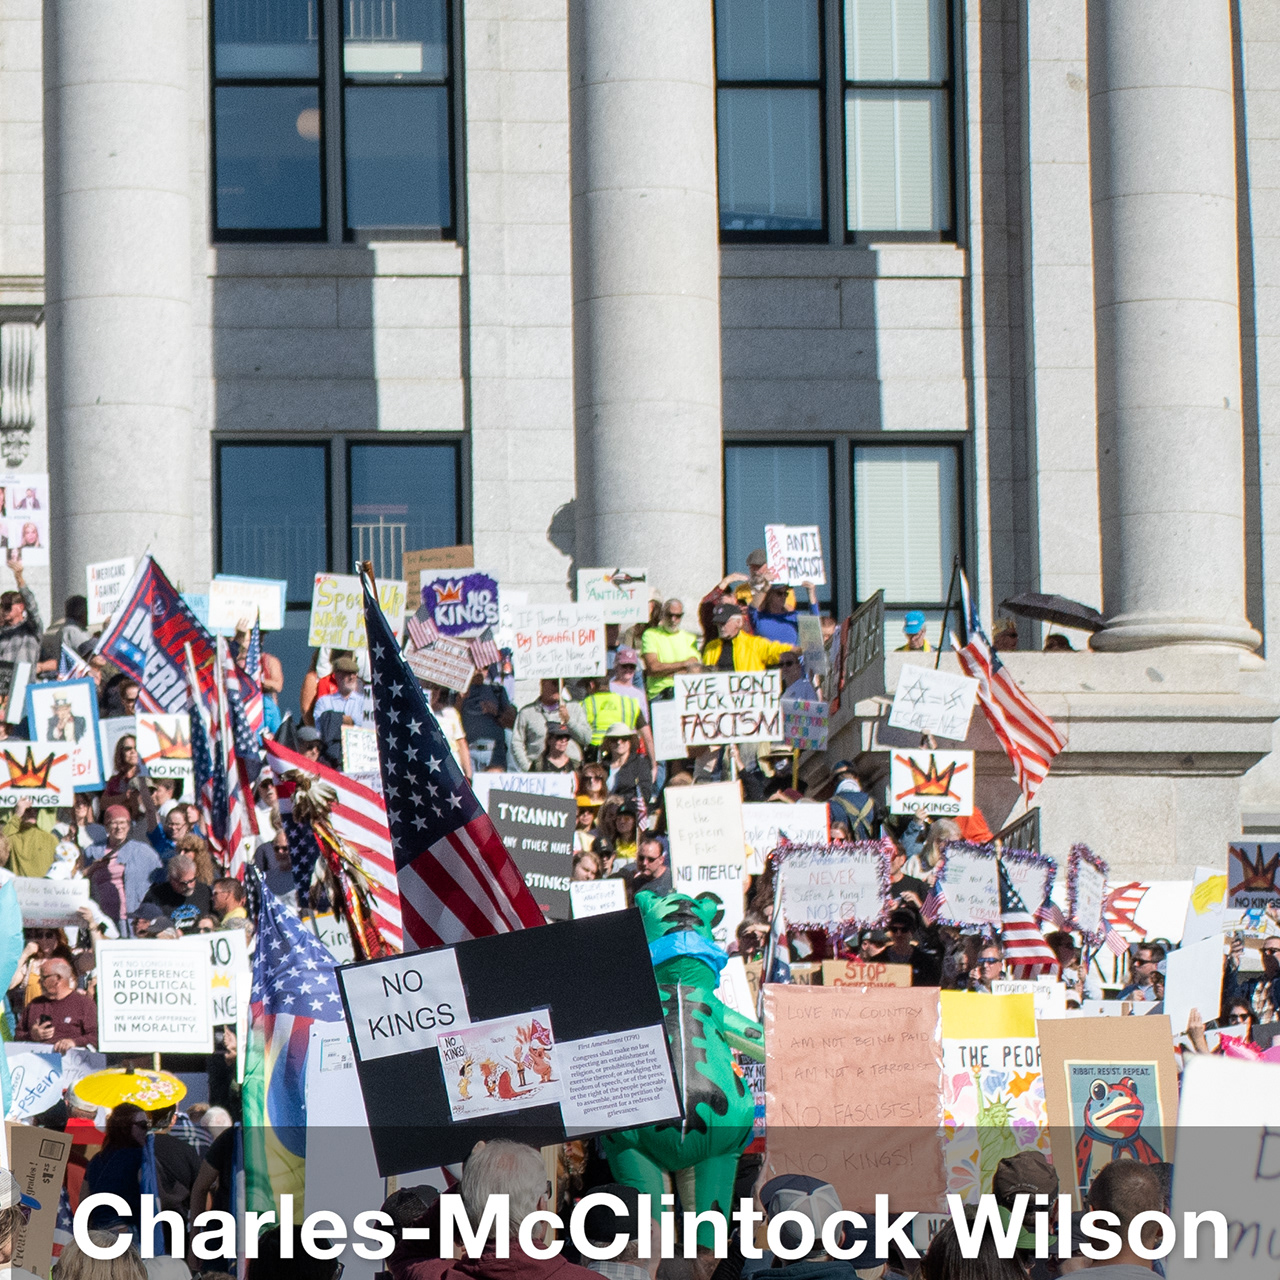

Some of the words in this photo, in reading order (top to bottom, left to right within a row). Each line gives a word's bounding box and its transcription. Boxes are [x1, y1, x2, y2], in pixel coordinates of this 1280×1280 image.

[787, 534, 818, 552] ANTI
[787, 557, 824, 579] FASCIST
[468, 590, 490, 608] NO
[435, 603, 500, 627] KINGS
[535, 630, 576, 647] Beautiful
[579, 628, 597, 646] Bill
[682, 676, 715, 698] WE
[685, 694, 728, 710] FUCK
[731, 692, 780, 709] WITH
[680, 711, 779, 739] FASCISM
[499, 776, 547, 794] WOMEN
[498, 801, 569, 829] TYRANNY
[902, 801, 918, 813] NO
[922, 801, 961, 814] KINGS
[521, 838, 547, 852] OTHER
[549, 843, 571, 856] NAME
[676, 864, 692, 881] NO
[697, 864, 743, 882] MERCY
[808, 868, 857, 887] NEVER
[525, 872, 571, 893] STINKS
[125, 969, 196, 979] DIFFERENCE
[844, 962, 887, 981] STOP
[113, 980, 126, 990] IN
[130, 980, 196, 990] POLITICAL
[380, 968, 425, 999] NO
[113, 991, 197, 1006] OPINION.
[366, 1002, 456, 1041] KINGS
[787, 1006, 822, 1020] LOVE
[859, 1005, 923, 1020] COUNTRY
[114, 1023, 127, 1032] IN
[958, 1044, 990, 1068] THE
[1072, 1067, 1097, 1077] RIBBIT.
[1097, 1067, 1122, 1077] RESIST.
[1123, 1067, 1151, 1077] REPEAT.
[781, 1102, 822, 1131] NO
